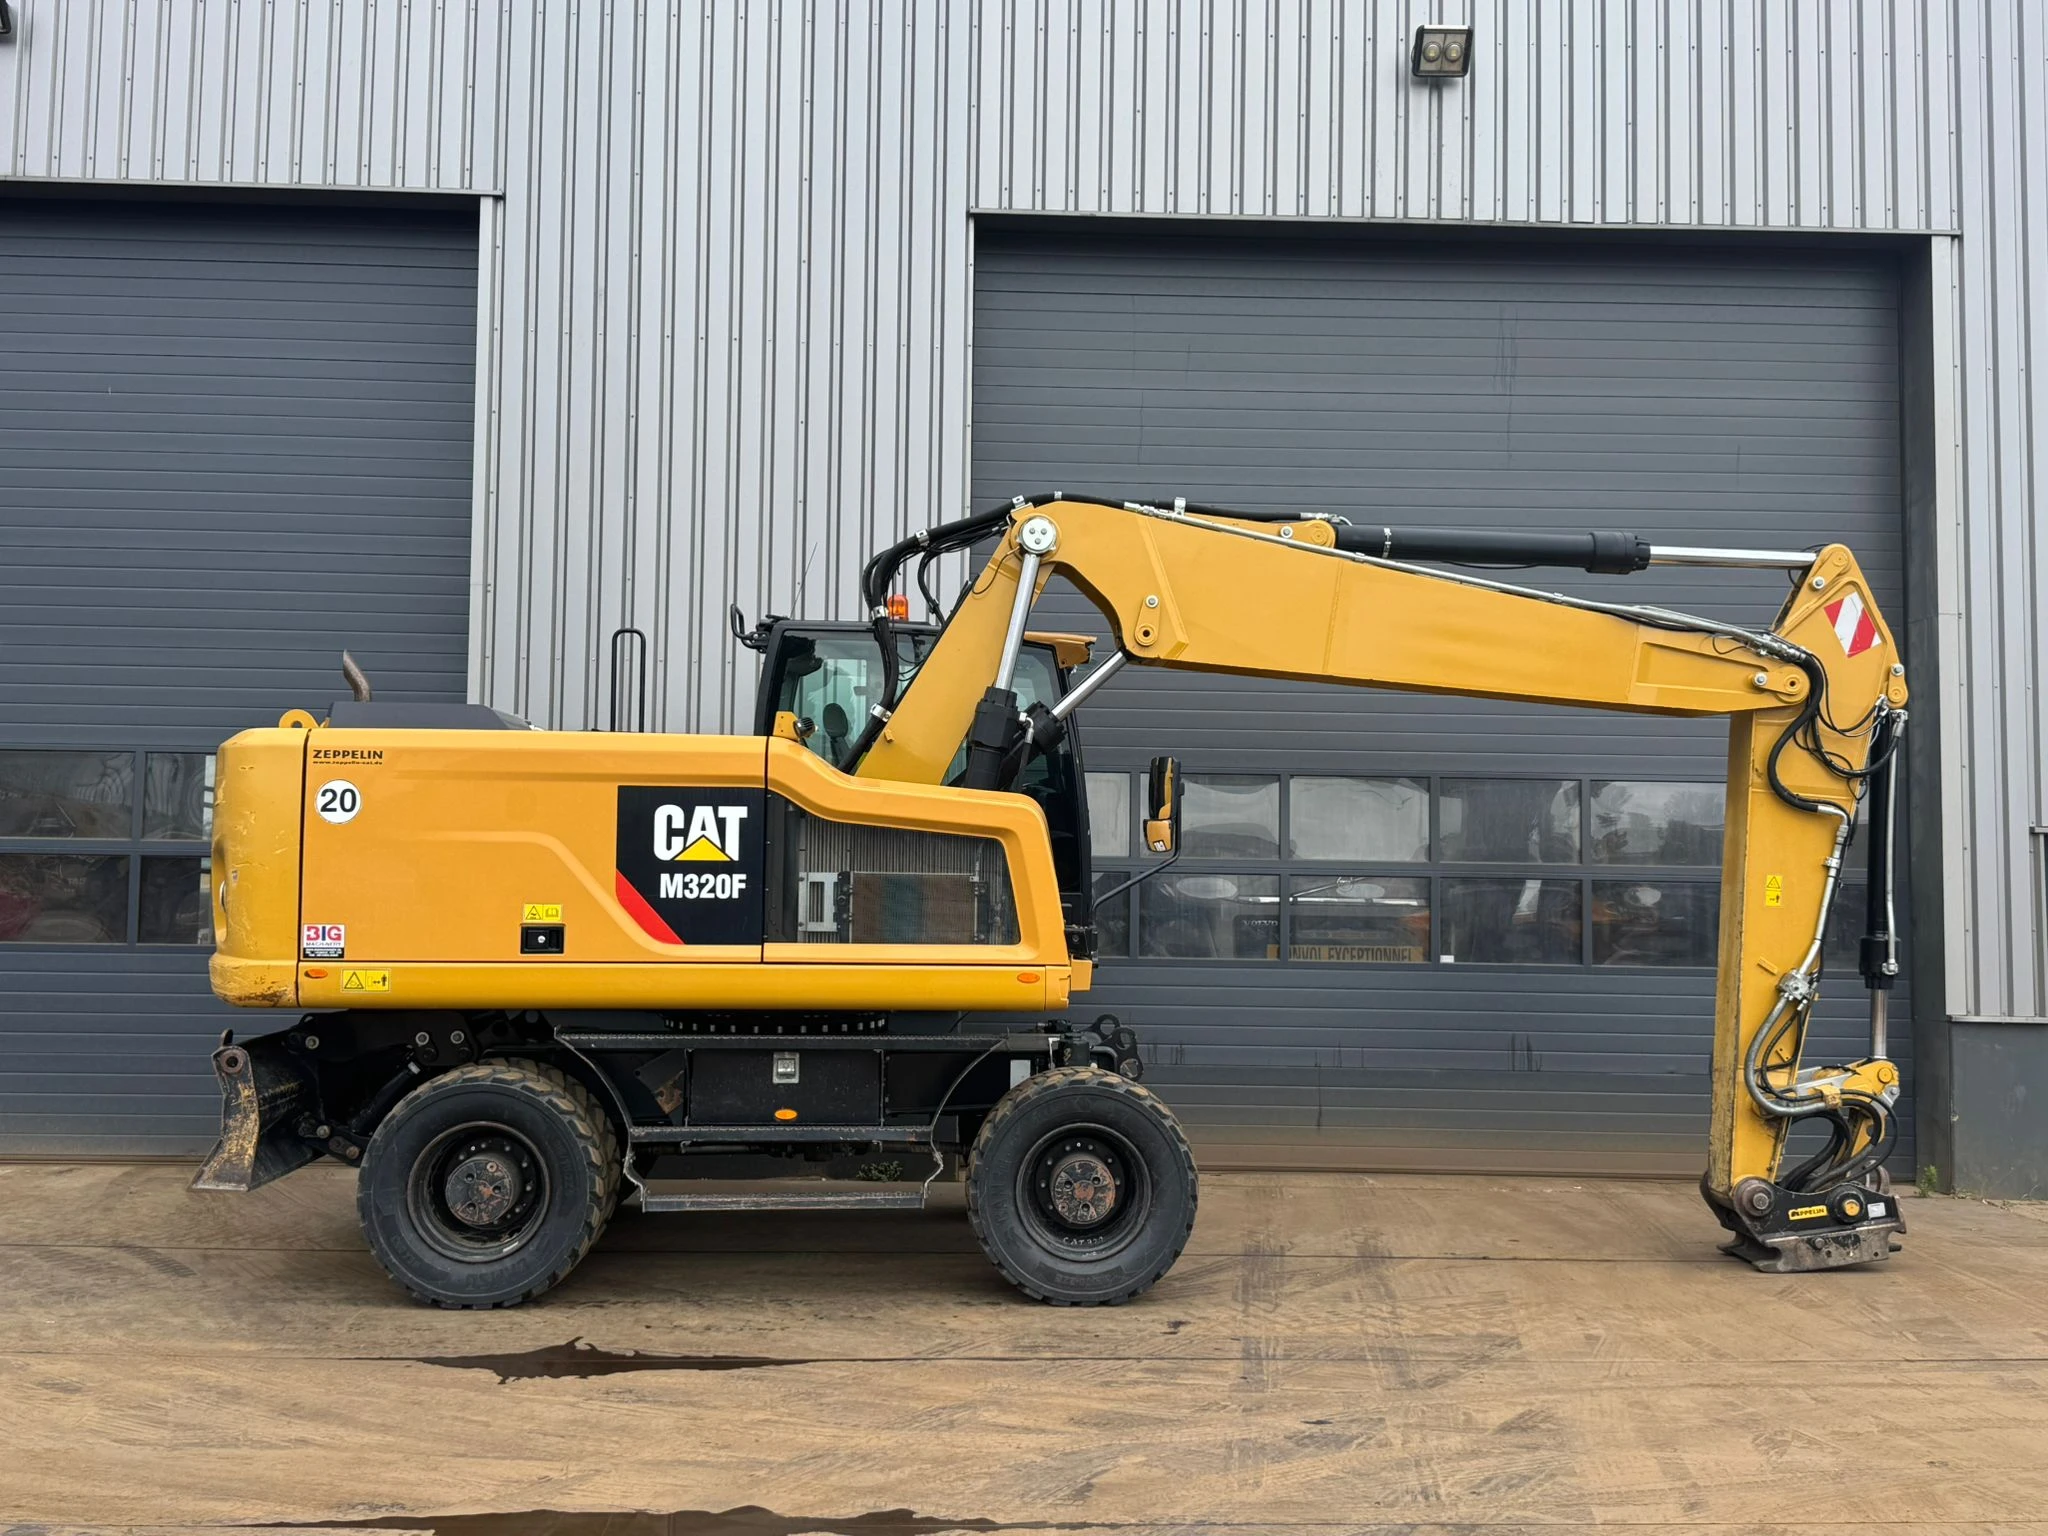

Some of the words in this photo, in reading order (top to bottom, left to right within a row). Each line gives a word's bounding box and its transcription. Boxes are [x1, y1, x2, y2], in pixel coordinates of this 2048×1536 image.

[313, 749, 383, 759] ZEPPELIN
[320, 788, 357, 812] 20
[654, 804, 748, 861] CAT
[660, 873, 747, 899] M320F
[306, 925, 342, 941] BIG
